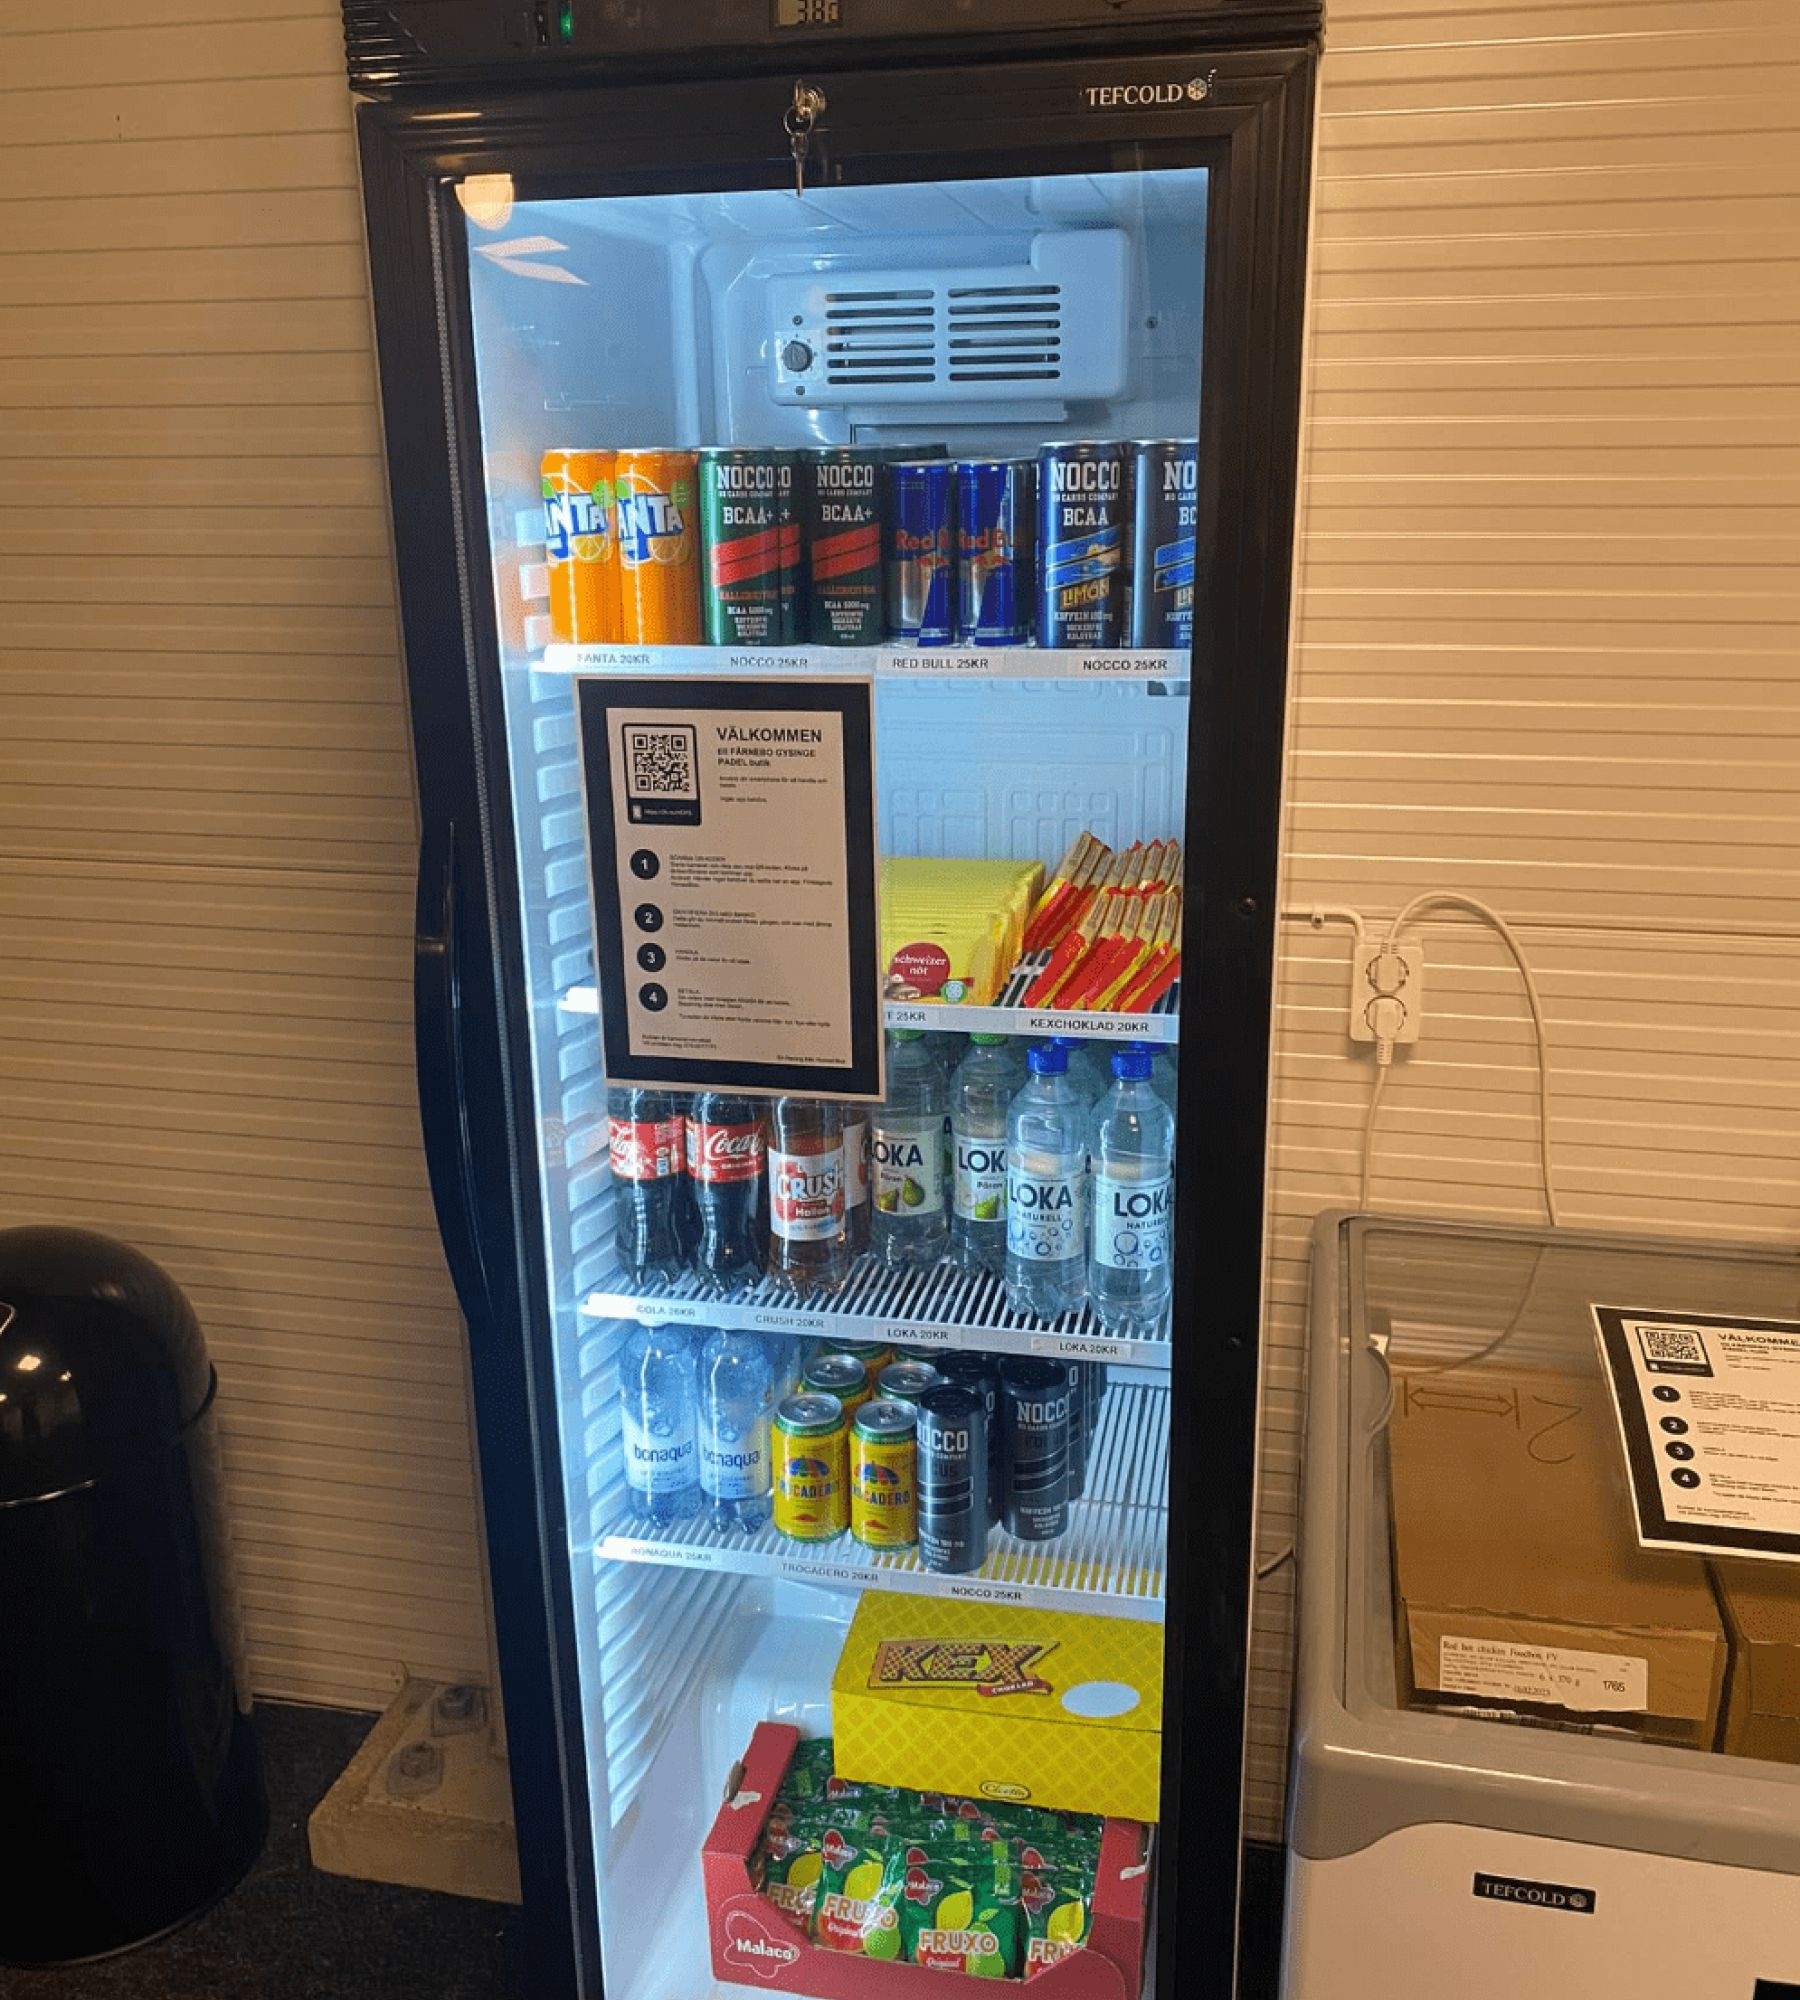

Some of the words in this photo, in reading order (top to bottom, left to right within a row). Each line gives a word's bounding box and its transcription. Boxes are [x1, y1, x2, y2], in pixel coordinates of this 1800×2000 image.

[1086, 84, 1184, 107] TEFCOLD
[716, 465, 773, 490] NOCCO
[816, 464, 874, 489] NOCCO
[1050, 461, 1121, 491] NOCCO
[545, 495, 608, 536] NTA
[723, 507, 774, 525] BCAA+
[822, 505, 873, 522] BCAA+
[1063, 506, 1109, 527] BCAA
[1178, 506, 1197, 526] BC
[730, 656, 774, 668] NOCCO
[892, 658, 917, 669] RED
[922, 659, 953, 669] BULL
[957, 659, 989, 670] 25KR
[1083, 660, 1130, 672] NOCCO
[1135, 660, 1168, 672] 25KR
[716, 726, 822, 743] VÄLKOMMEN
[718, 758, 747, 767] PADEL
[642, 858, 648, 871] 1
[645, 912, 653, 924] 2
[647, 952, 655, 964] 3
[649, 991, 658, 1003] 4
[1030, 1018, 1114, 1031] KEXCHOKLAD
[1117, 1022, 1150, 1032] 20KR
[873, 1141, 923, 1167] OKA
[958, 1146, 1007, 1174] LOK
[1009, 1177, 1073, 1210] LOKA
[755, 1315, 793, 1326] CRUSH
[887, 1328, 917, 1338] LOKA
[1717, 1333, 1800, 1346] VÄLKOMME
[1059, 1342, 1088, 1352] LOKA
[1669, 1421, 1678, 1429] 2
[634, 1441, 692, 1462] bonaqua
[1675, 1447, 1684, 1455] 3
[1682, 1474, 1691, 1482] 4
[782, 1562, 850, 1579] TROCADERO
[951, 1586, 992, 1599] NOCCO
[877, 1642, 1043, 1684] KEX
[1482, 1881, 1567, 1906] TEFCOLD
[822, 1893, 898, 1929] FRUO
[736, 1938, 794, 1960] Malaco
[918, 1929, 1000, 1954] FRUXO
